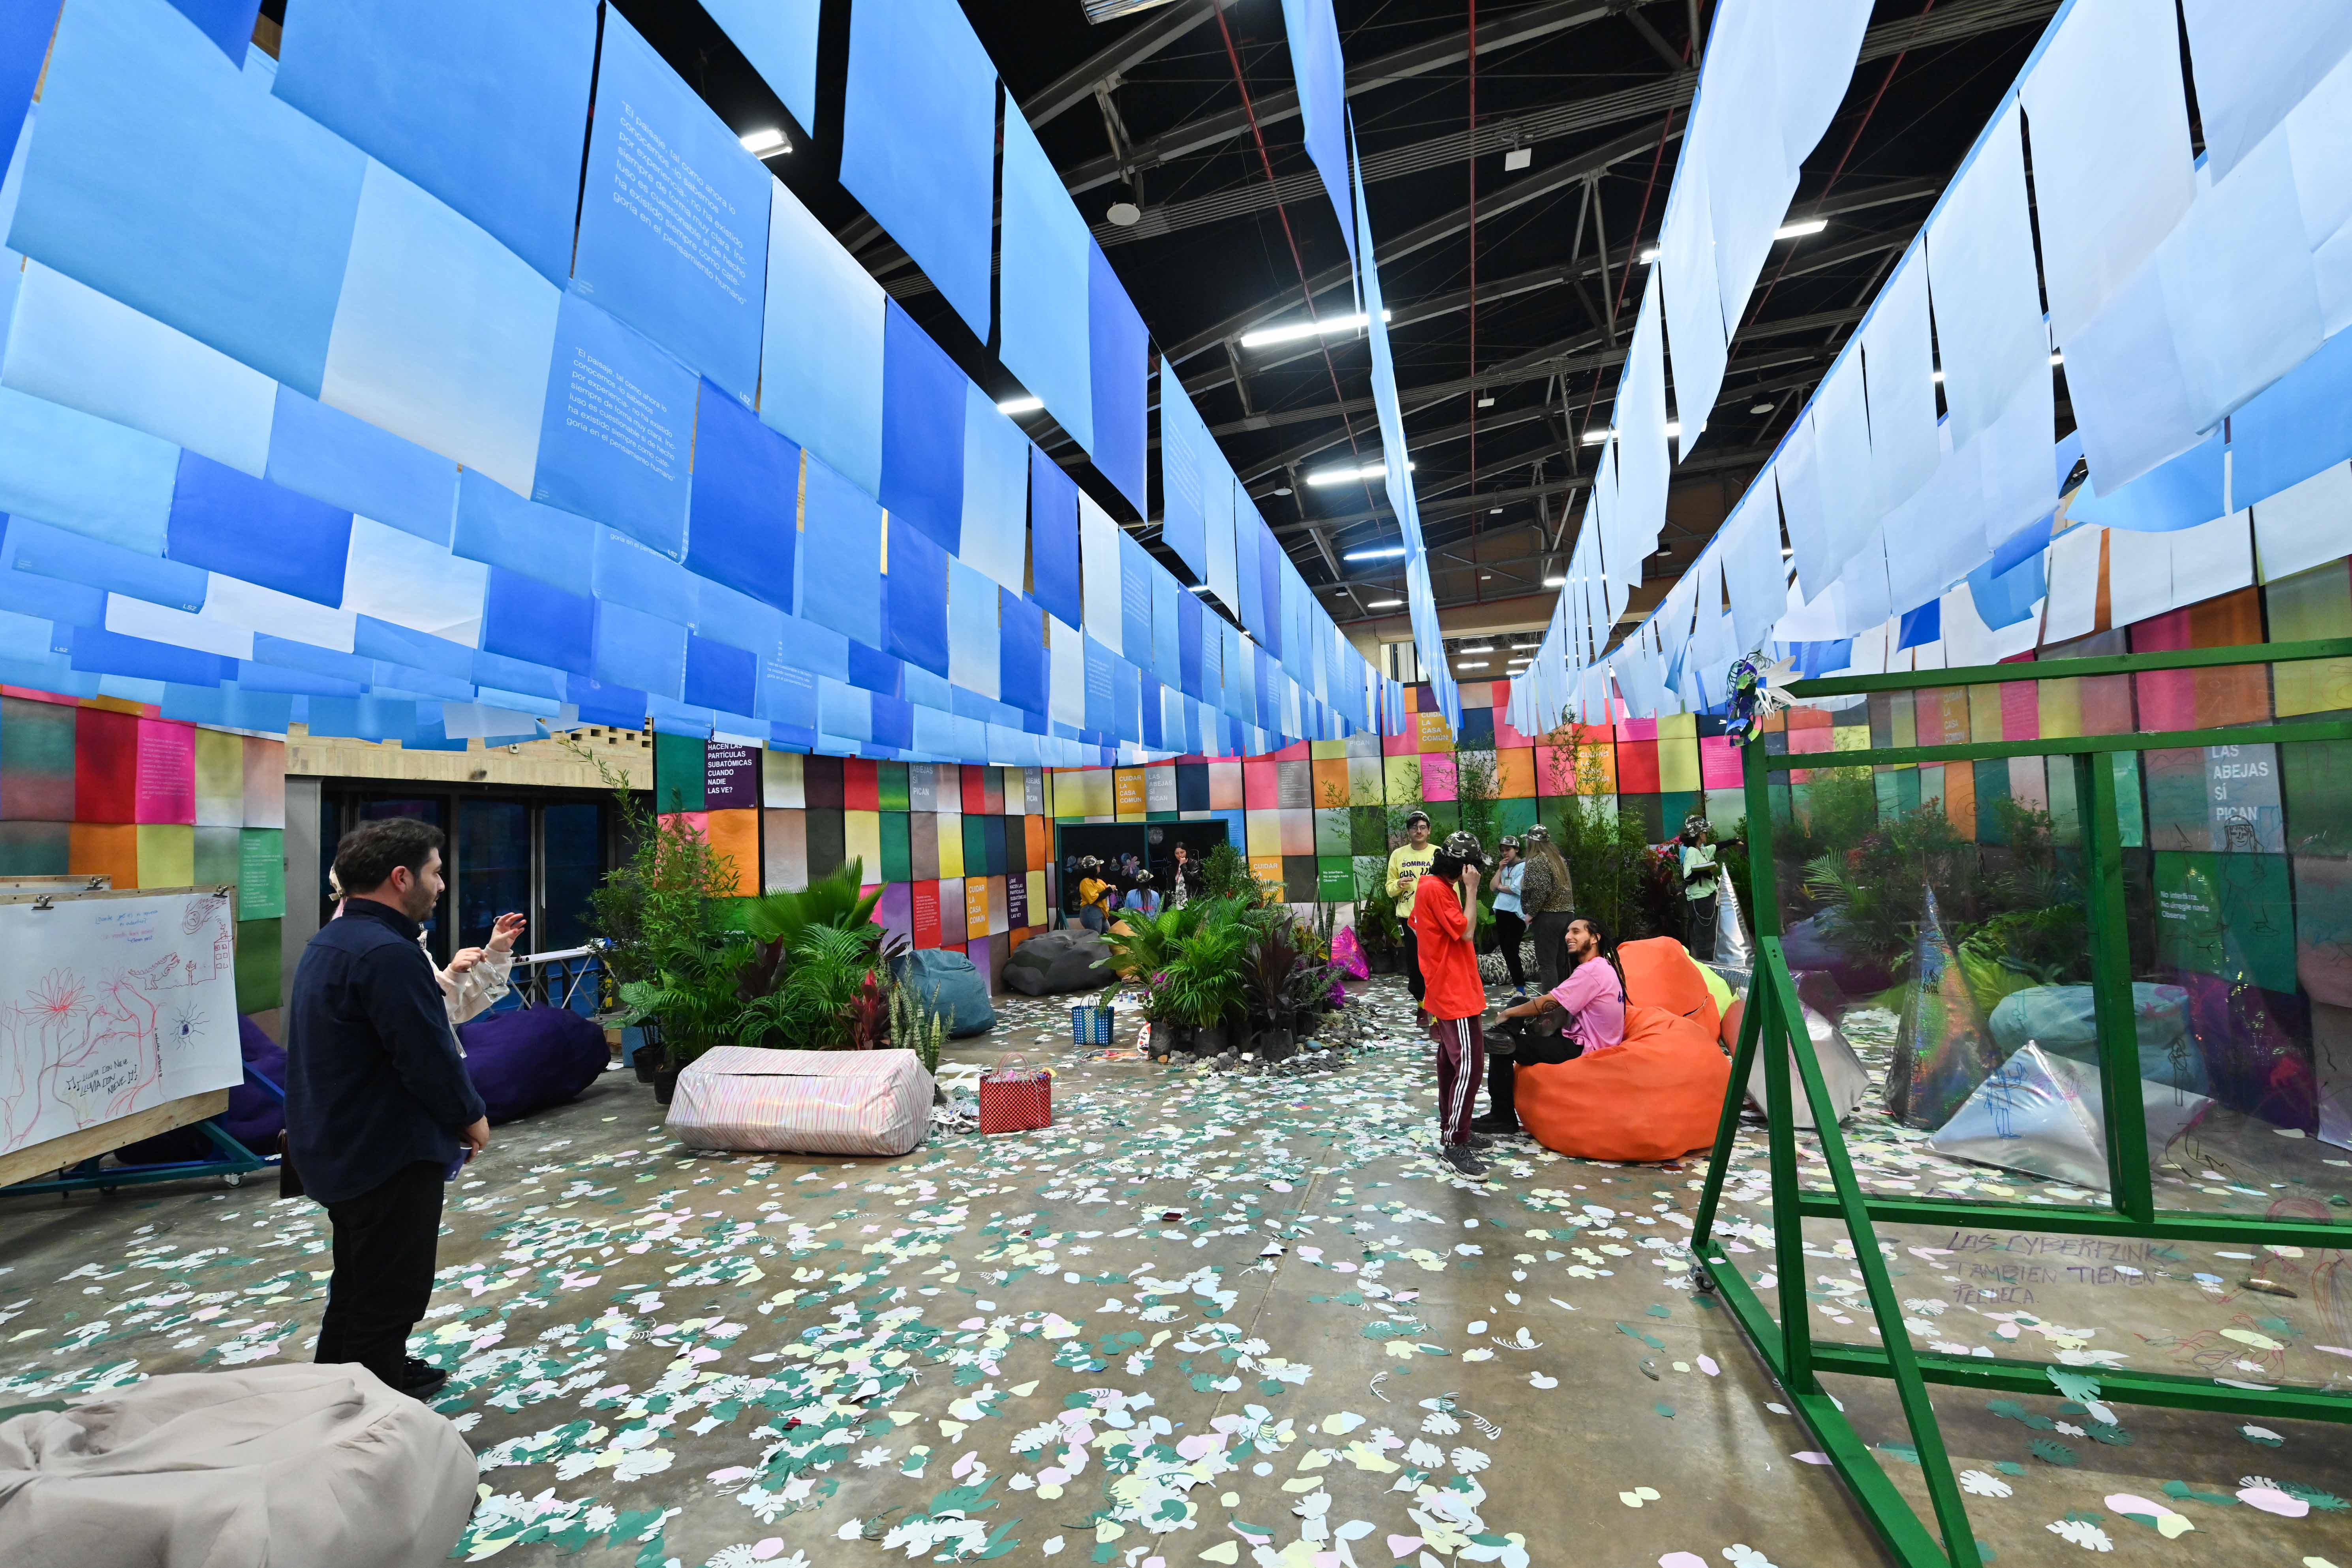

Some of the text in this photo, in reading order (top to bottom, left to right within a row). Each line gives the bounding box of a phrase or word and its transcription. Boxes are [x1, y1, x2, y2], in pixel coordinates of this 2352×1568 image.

[620, 116, 670, 168] conocemos
[683, 177, 720, 214] sabemos
[617, 146, 654, 183] siempre
[655, 180, 667, 195] de
[668, 190, 691, 218] forma
[692, 214, 710, 235] muy
[618, 131, 635, 149] por
[690, 199, 702, 212] no
[703, 208, 713, 223] ha
[714, 220, 743, 249] existido
[670, 148, 680, 164] tal
[681, 161, 704, 186] como
[704, 184, 727, 208] ahora
[728, 203, 736, 215] lo
[614, 173, 627, 192] ha
[629, 188, 664, 222] existido
[665, 218, 698, 251] siempre
[698, 248, 721, 270] como
[616, 158, 746, 279] luso es cuestionable si de hecho
[612, 191, 638, 216] goría
[639, 212, 652, 227] en
[653, 224, 661, 235] el
[663, 232, 714, 279] pensamiento
[573, 359, 616, 389] conocemos
[626, 392, 654, 415] sabemos
[616, 372, 624, 383] tal
[624, 380, 642, 396] como
[642, 393, 661, 408] ahora
[661, 404, 667, 413] lo
[570, 382, 603, 404] siempre
[603, 400, 613, 410] de
[614, 405, 633, 423] forma
[633, 419, 646, 433] muy
[571, 370, 586, 382] por
[631, 407, 641, 417] no
[641, 412, 649, 423] ha
[649, 419, 673, 438] existido
[739, 391, 750, 406] LSZ
[567, 404, 579, 415] ha
[580, 411, 610, 431] existido
[611, 427, 637, 448] siempre
[637, 445, 655, 459] como
[569, 392, 587, 407] luso
[588, 404, 598, 413] es
[599, 409, 641, 439] cuestionable
[647, 439, 656, 449] de
[656, 444, 675, 461] hecho
[566, 417, 588, 432] goría
[589, 428, 600, 438] en
[601, 434, 609, 442] el
[609, 438, 650, 467] pensamiento
[667, 549, 678, 559] LSZ
[708, 751, 746, 759] PARTÍCULAS
[2212, 745, 2239, 759] LAS
[708, 759, 752, 768] SUBATÓMICAS
[913, 765, 933, 774] ABEJAS
[2213, 762, 2269, 779] ABEJAS
[913, 774, 918, 784] SÍ
[913, 787, 929, 796] PICAN
[2214, 782, 2227, 800] SÍ
[2217, 806, 2257, 821] PICAN
[969, 884, 984, 893] CUIDAR
[969, 905, 981, 914] CASA
[970, 913, 985, 924] COMÚN
[2161, 911, 2187, 920] Observe
[102, 1073, 116, 1088] CON
[1946, 1232, 1997, 1253] LOS
[2066, 1266, 2158, 1286] TIENEN
